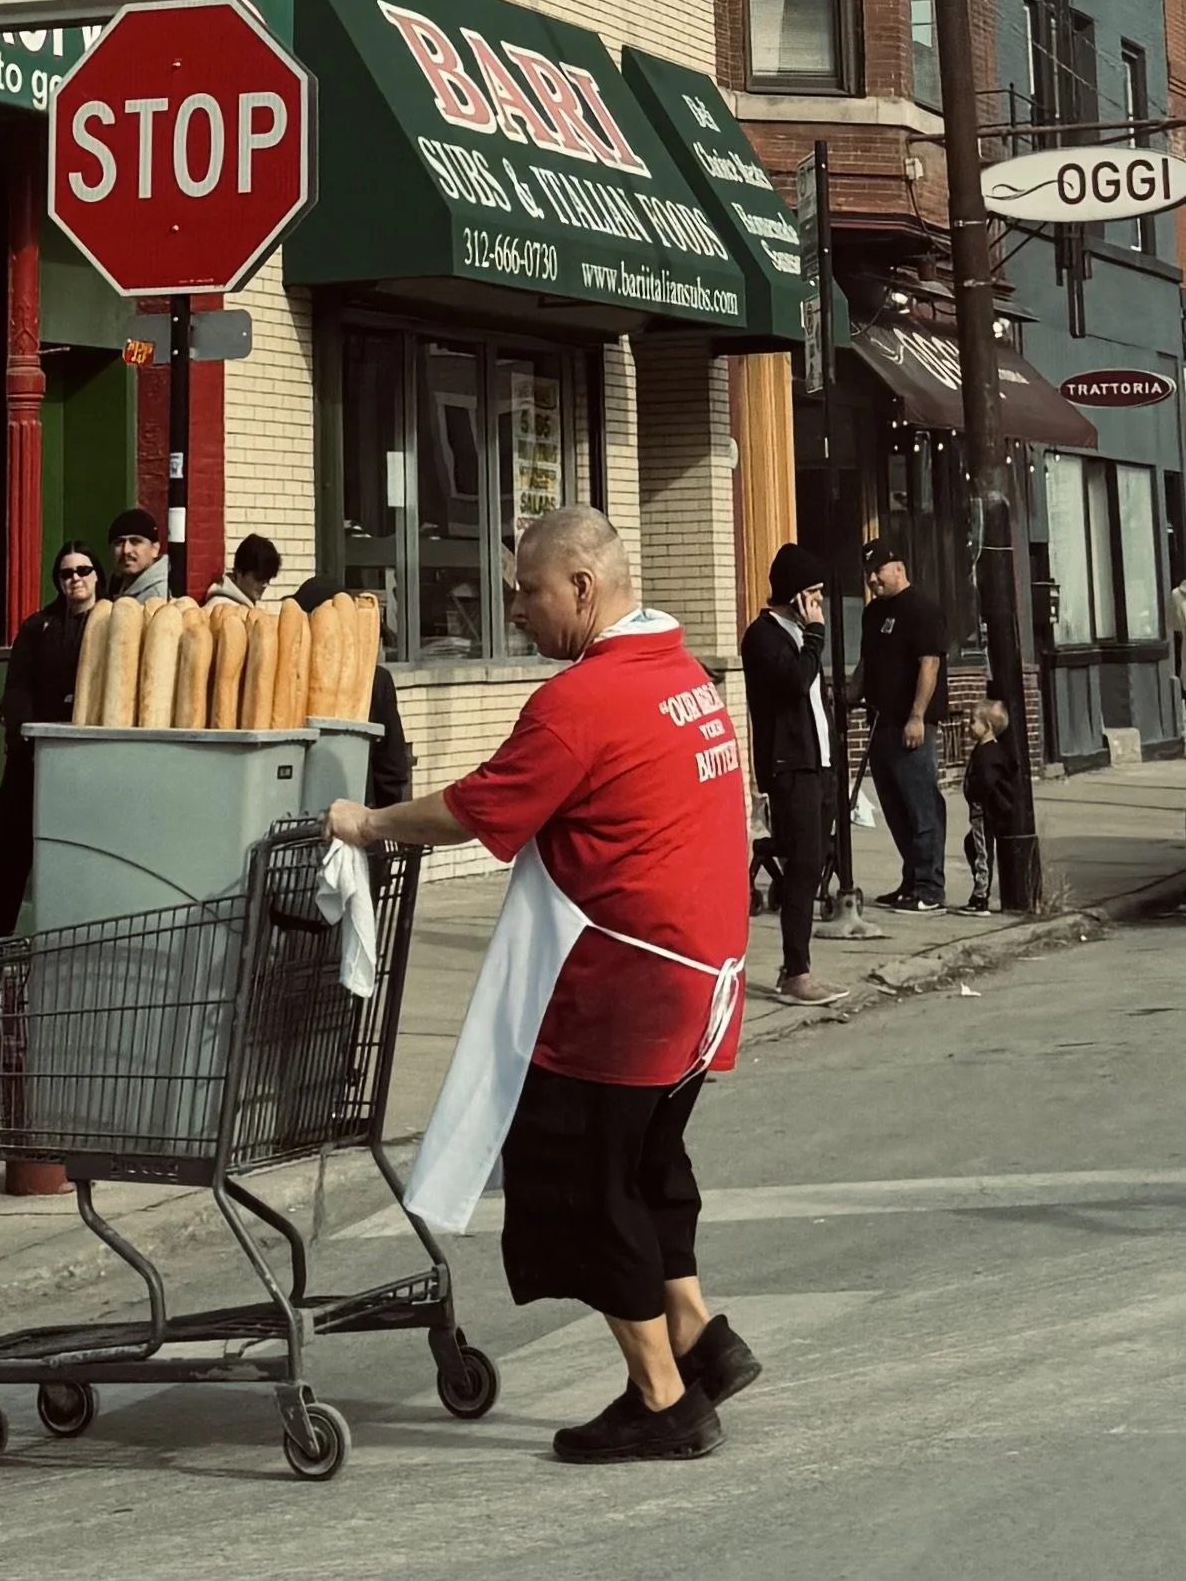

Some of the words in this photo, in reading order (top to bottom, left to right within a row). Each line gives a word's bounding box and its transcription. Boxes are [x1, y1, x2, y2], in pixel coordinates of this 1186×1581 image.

[67, 91, 289, 203] STOP
[1057, 157, 1171, 205] OGGI
[417, 135, 512, 213] SUBS
[502, 157, 545, 220] &
[528, 164, 653, 244] ITALIAN
[633, 191, 730, 261] FOODS
[463, 226, 558, 282] 312-666-0730
[581, 260, 739, 316] www.bariitaliansubs.com
[1065, 381, 1163, 397] TRATTORIA
